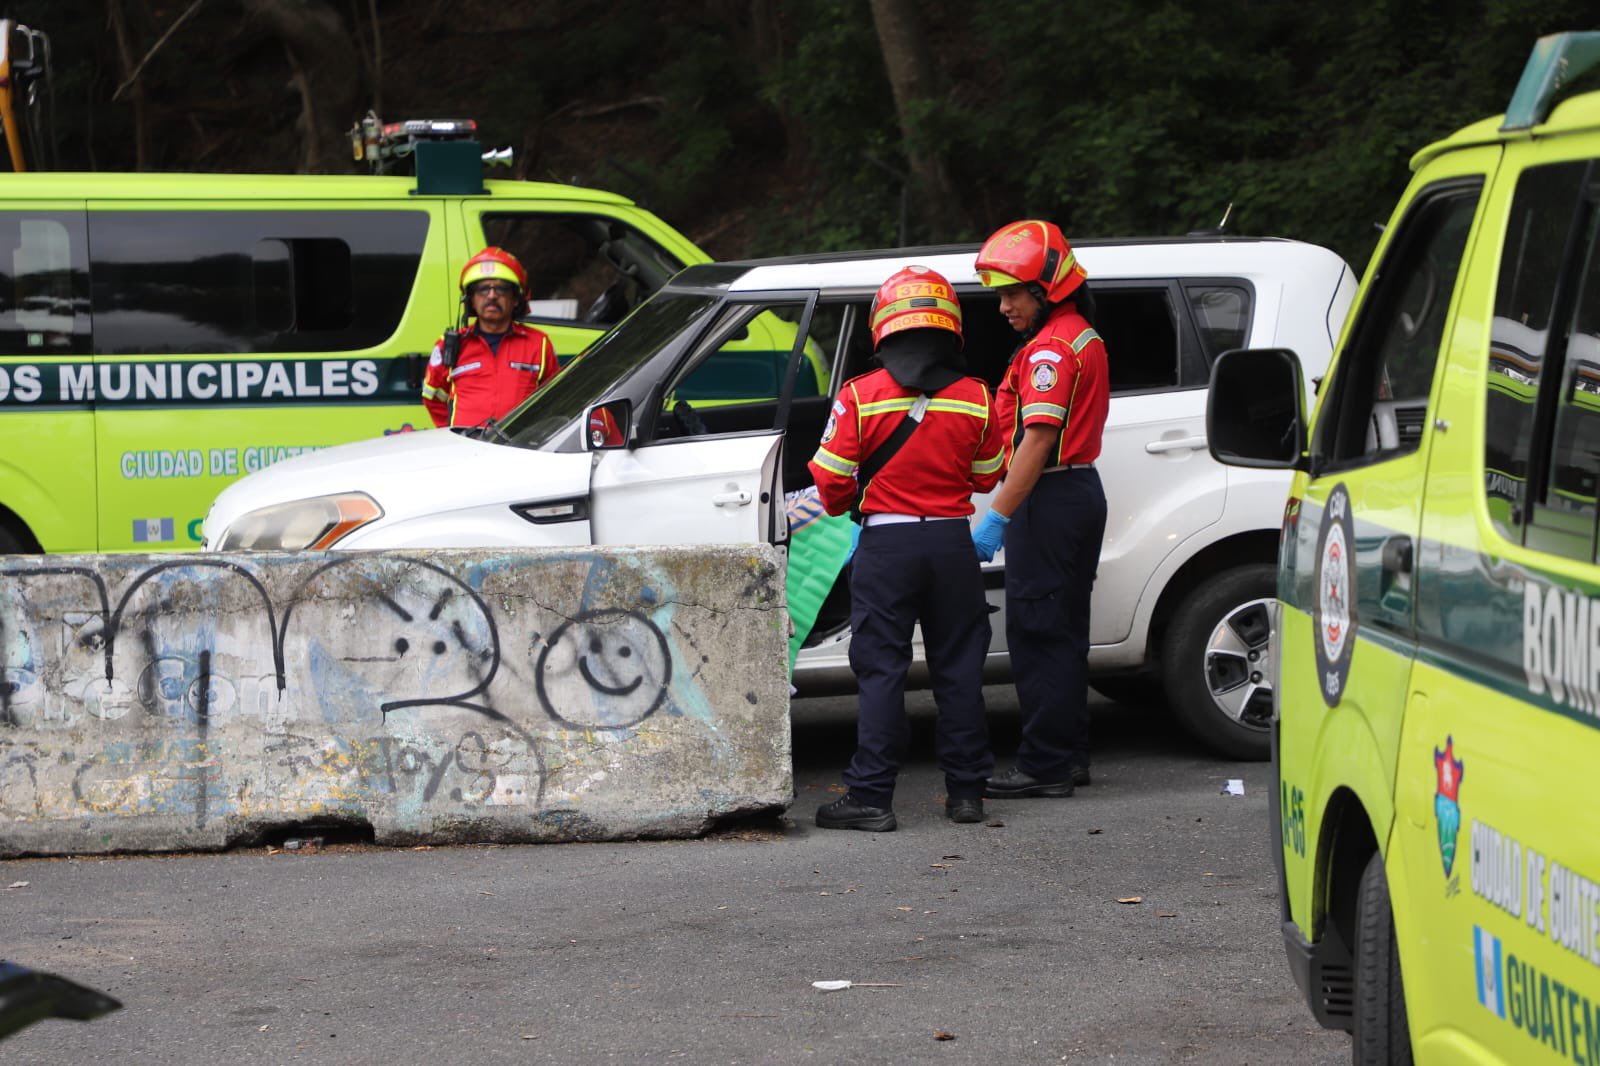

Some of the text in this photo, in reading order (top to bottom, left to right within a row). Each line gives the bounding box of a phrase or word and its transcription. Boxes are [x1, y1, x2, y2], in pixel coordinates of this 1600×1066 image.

[902, 285, 945, 297] 3714
[894, 314, 952, 328] ROSALES
[59, 360, 378, 402] MUNICIPALES
[121, 450, 203, 479] CIUDAD
[209, 448, 238, 475] DE
[1282, 780, 1307, 859] A-65
[1471, 820, 1522, 920] CIUDAD
[1525, 847, 1546, 934] DE
